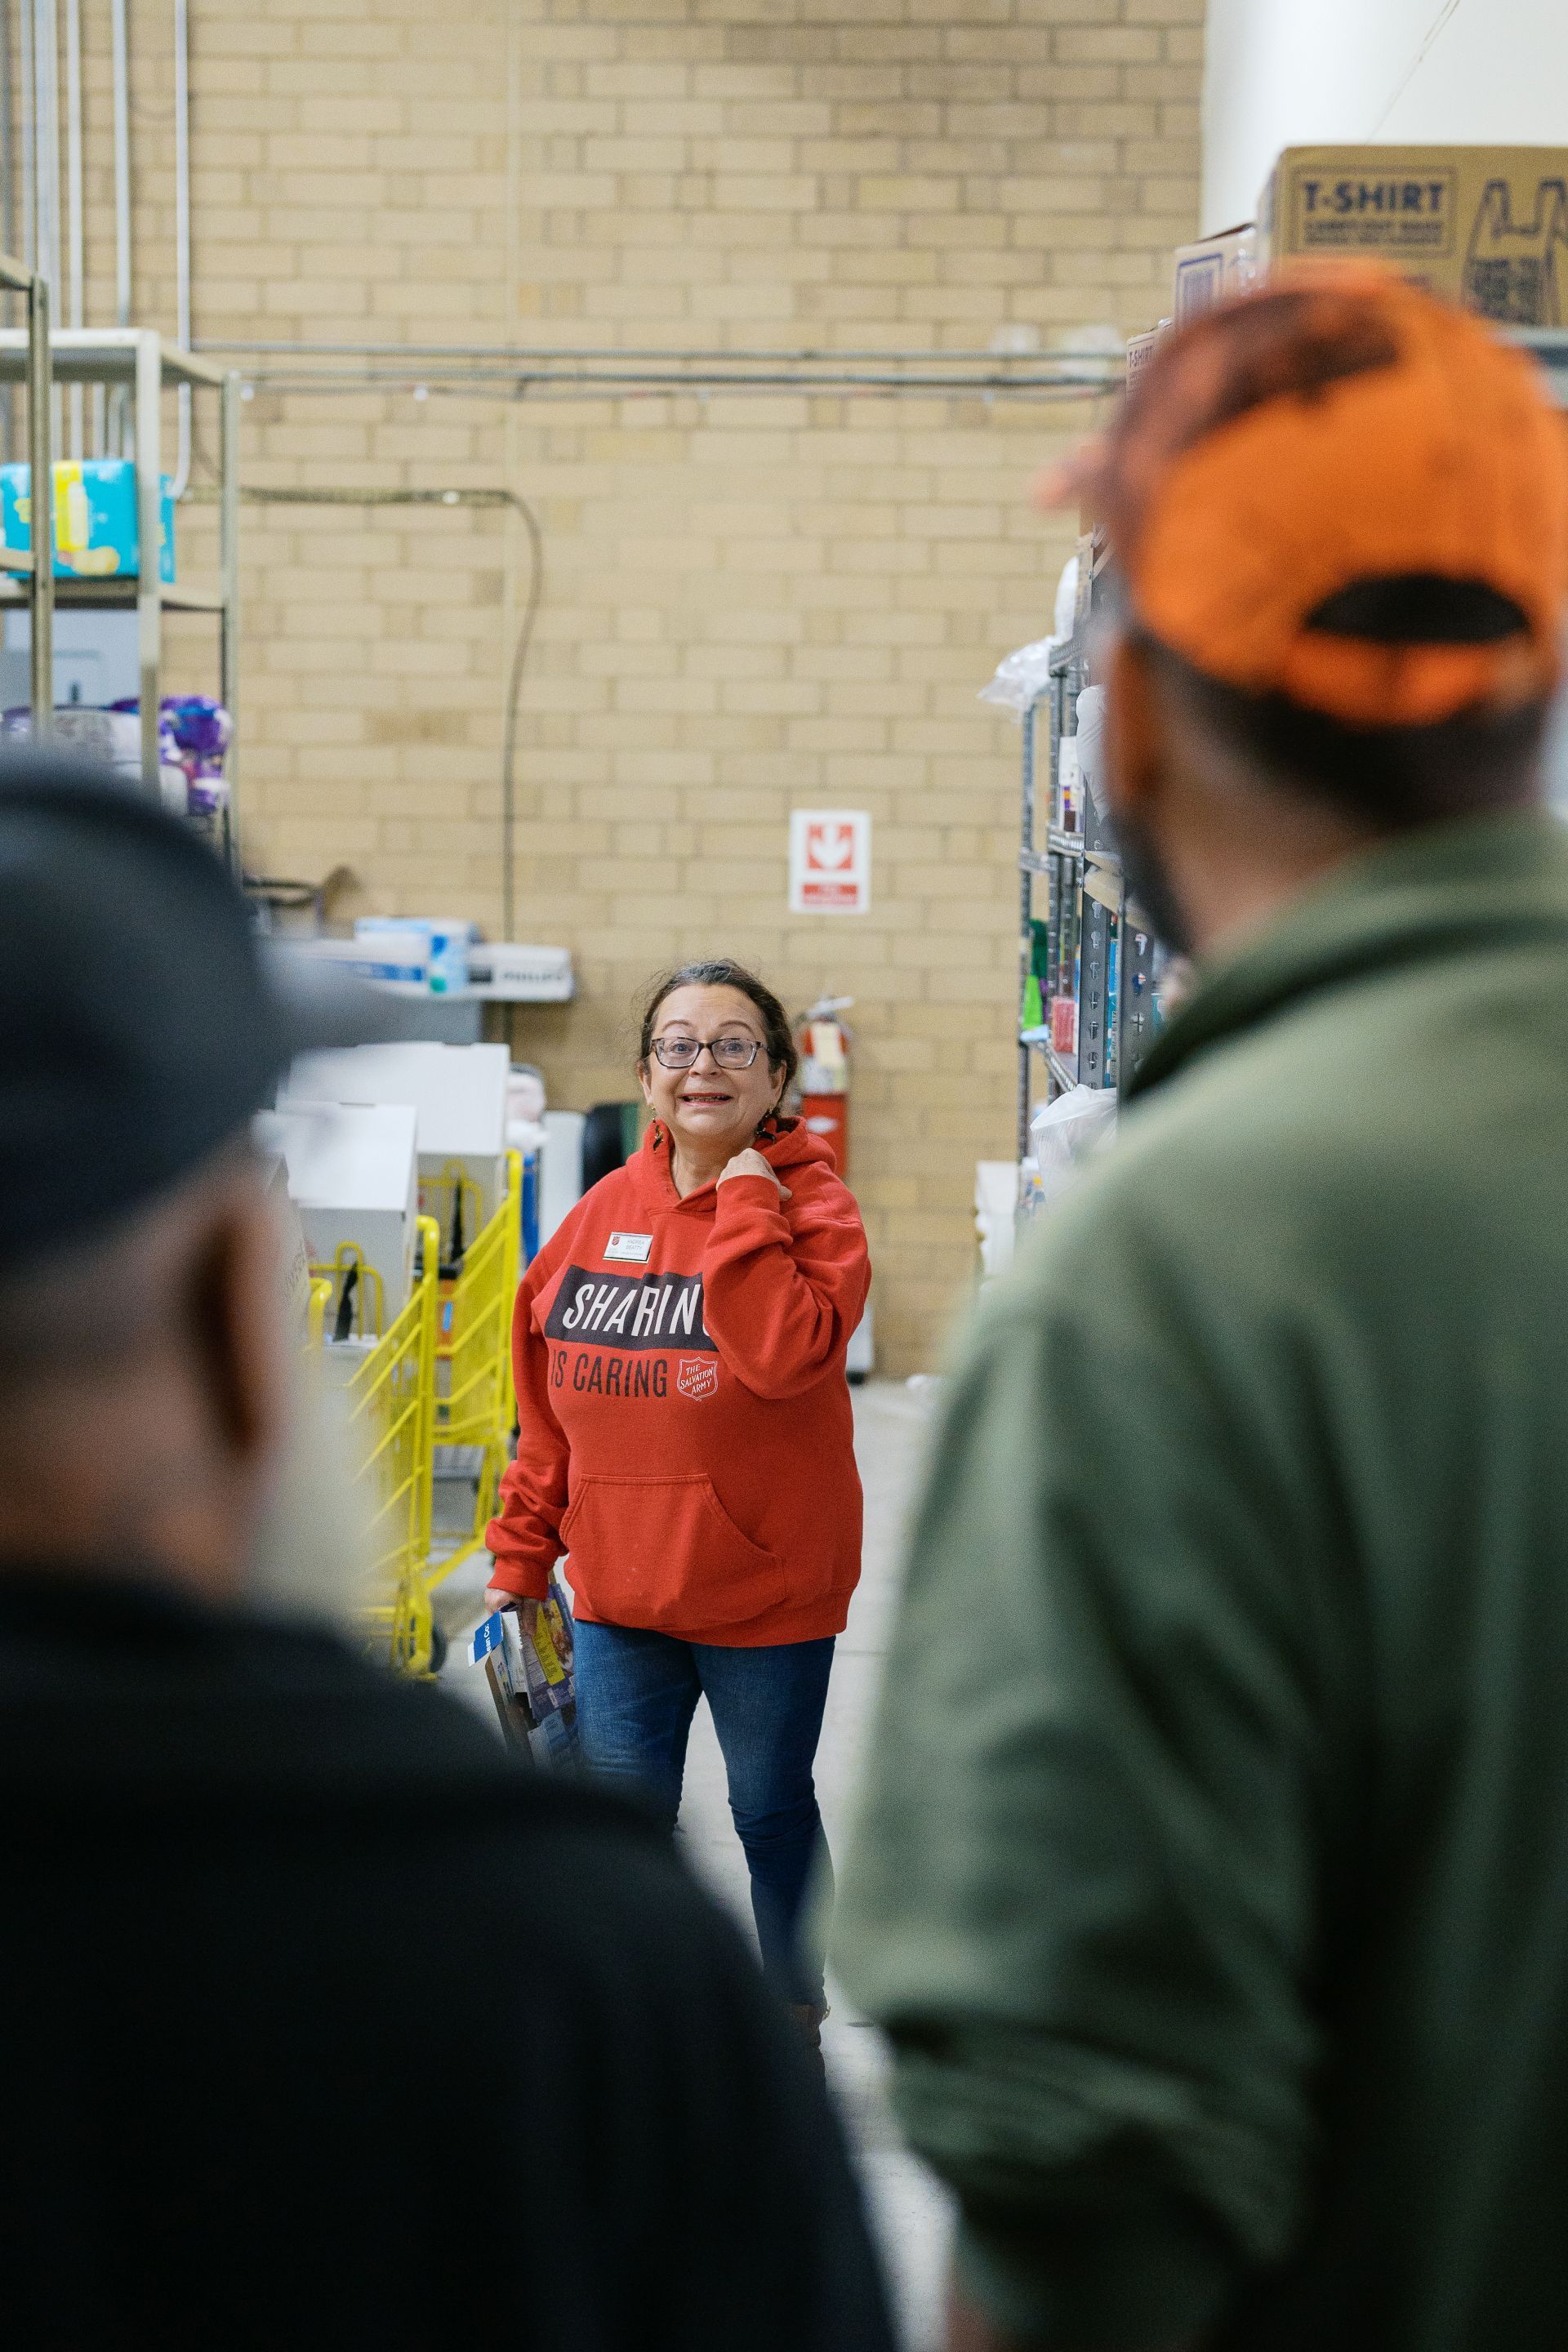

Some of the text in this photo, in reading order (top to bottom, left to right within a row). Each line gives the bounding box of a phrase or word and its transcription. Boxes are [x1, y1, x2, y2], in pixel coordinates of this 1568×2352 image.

[1304, 180, 1443, 213] T-SHIRT
[562, 1283, 710, 1337] SHARIN
[550, 1349, 668, 1398] IS CARING
[680, 1366, 714, 1390] SALVATION
[686, 1363, 701, 1375] THE
[692, 1378, 712, 1395] ARMY
